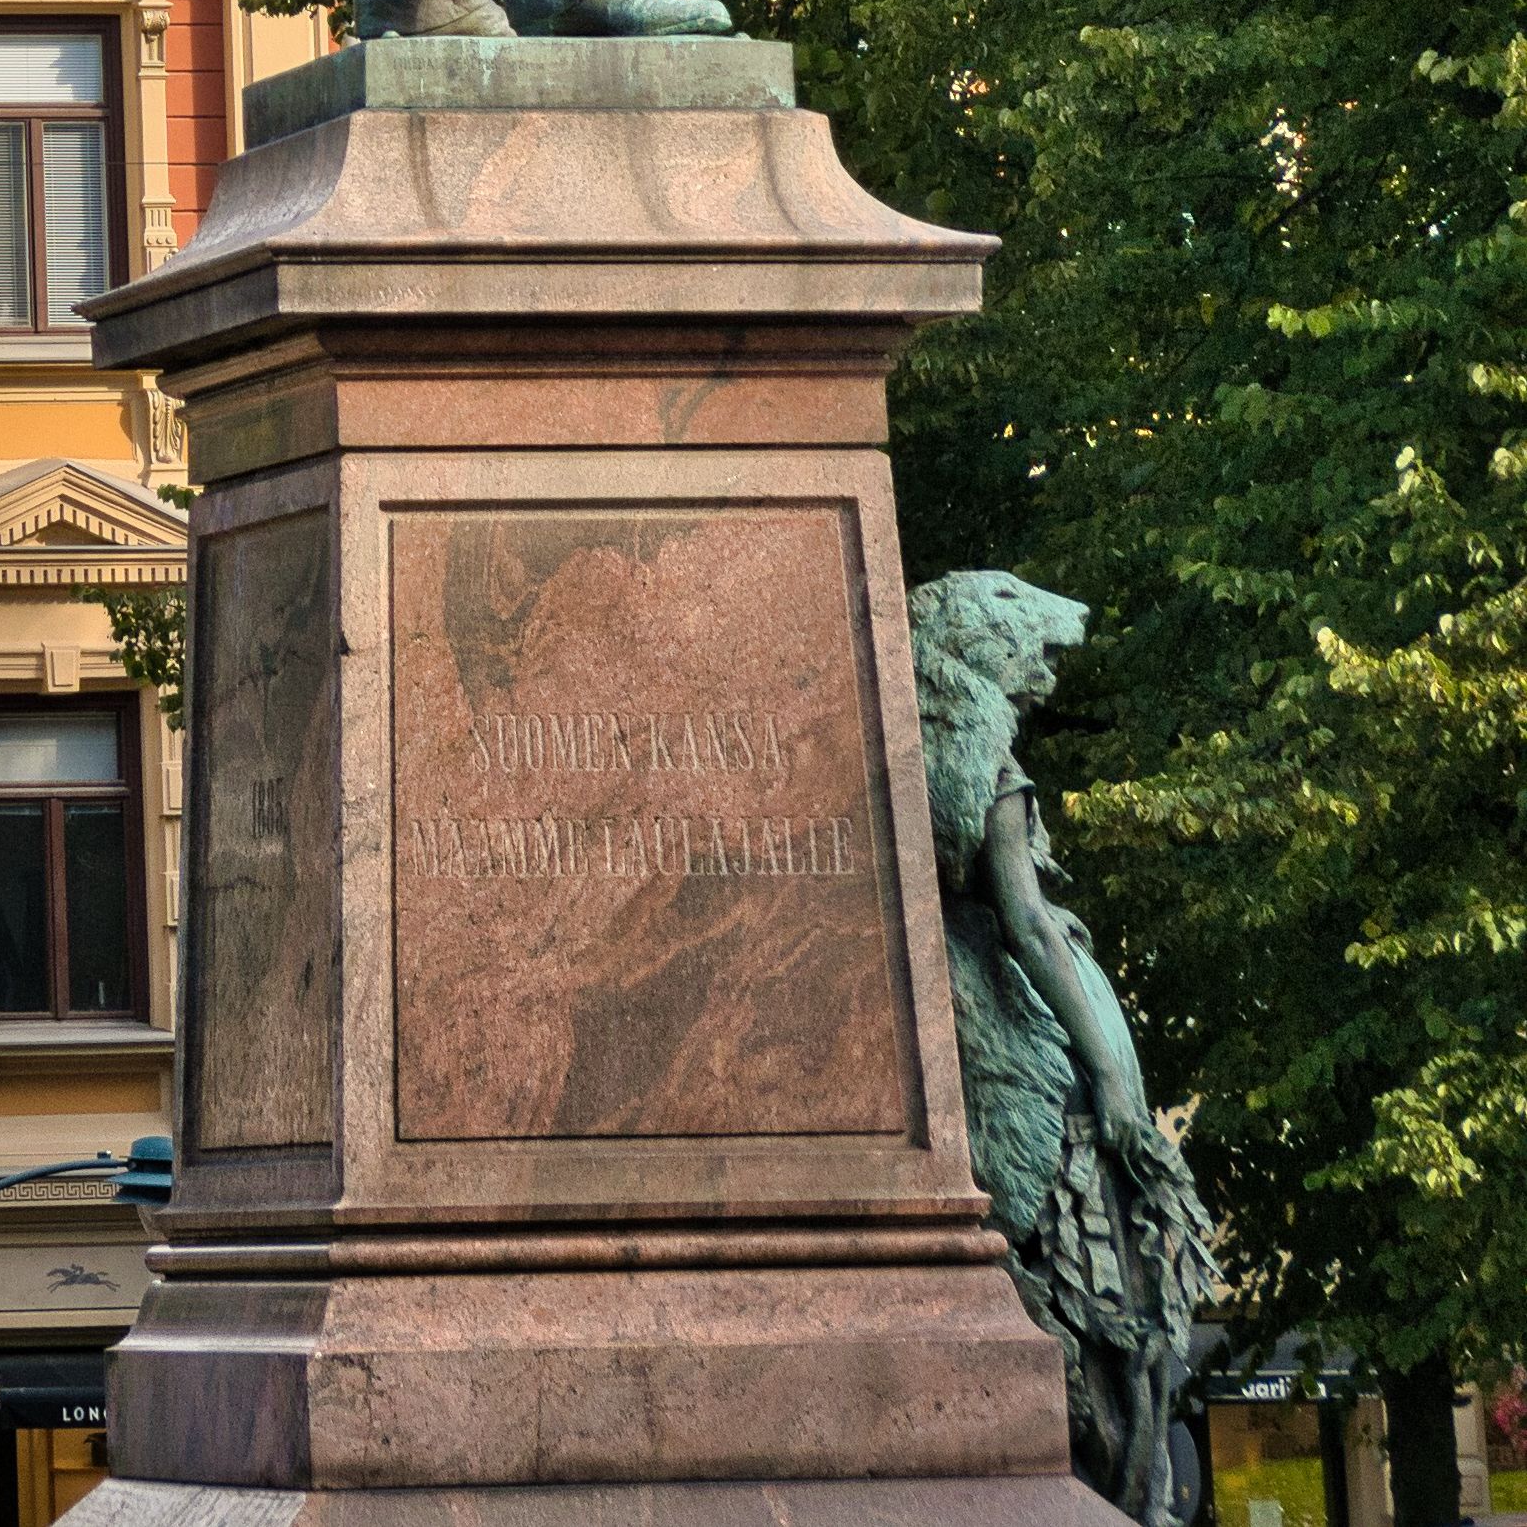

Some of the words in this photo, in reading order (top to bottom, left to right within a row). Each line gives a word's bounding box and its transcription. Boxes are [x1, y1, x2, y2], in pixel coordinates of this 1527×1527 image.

[472, 711, 634, 773] SUOMEN
[647, 710, 785, 774] KANSA
[410, 817, 591, 878] MAAMME
[601, 816, 856, 877] LAULAJALLE
[62, 1407, 106, 1421] LON
